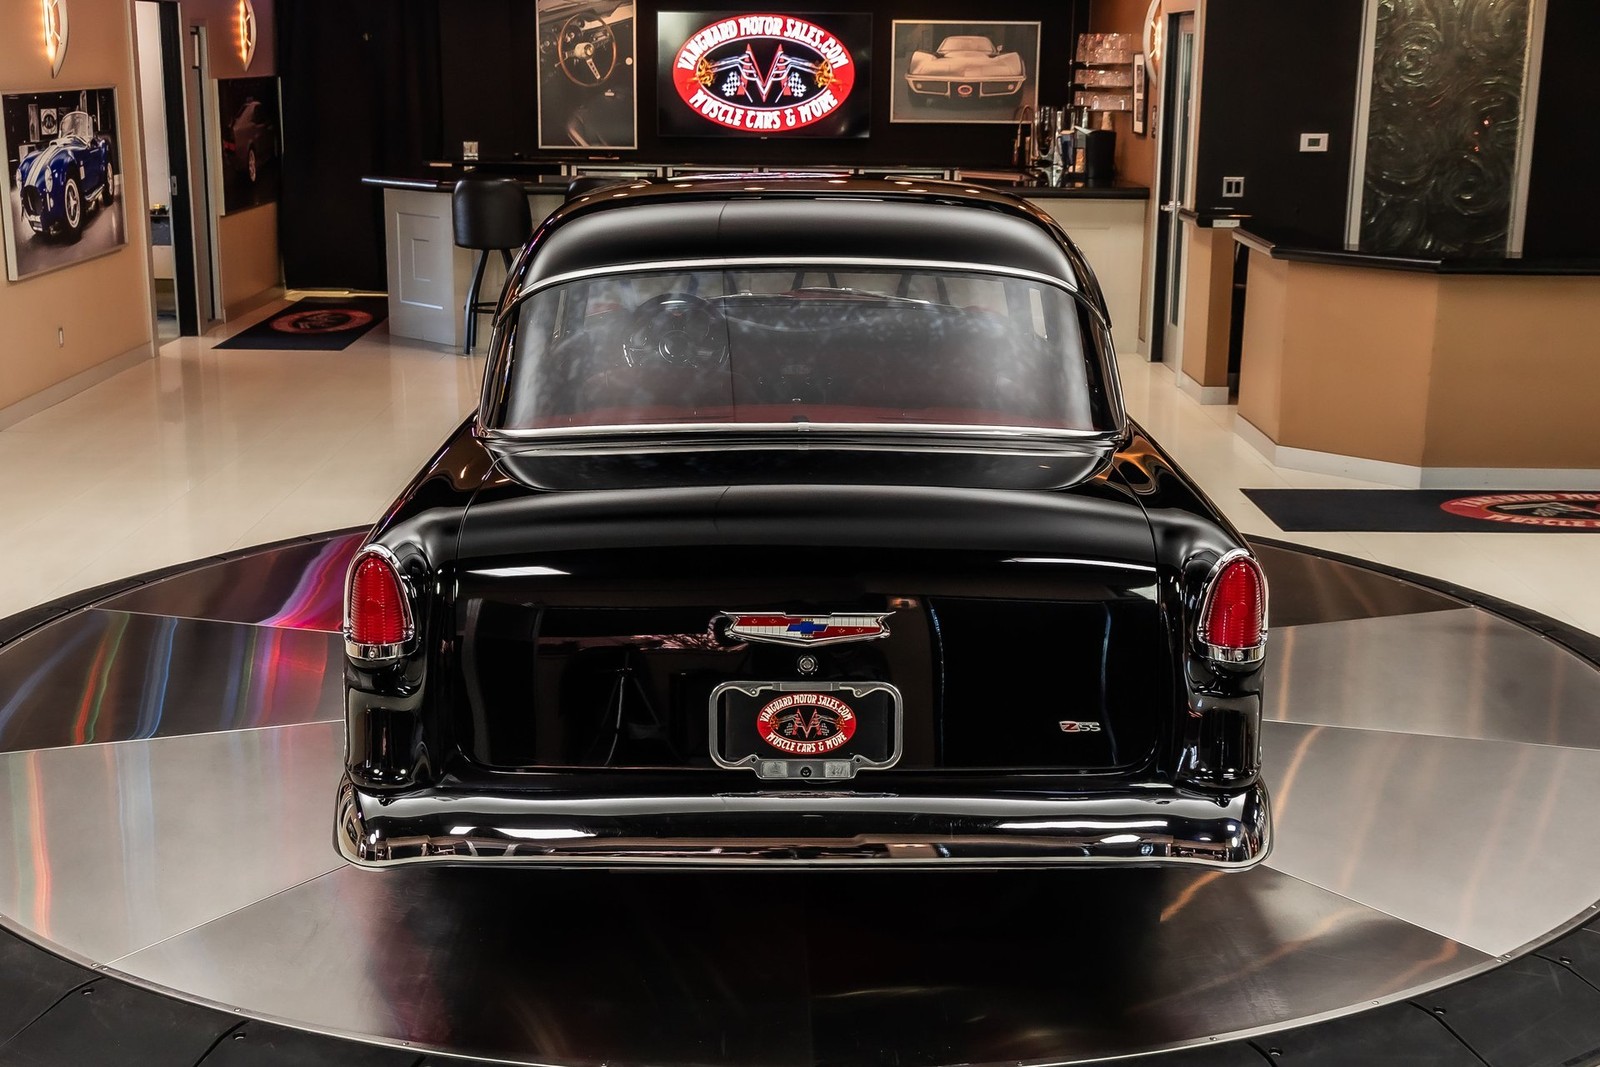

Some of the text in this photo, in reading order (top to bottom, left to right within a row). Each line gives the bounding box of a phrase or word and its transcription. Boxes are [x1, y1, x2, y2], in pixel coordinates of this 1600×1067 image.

[677, 16, 849, 71] VANGUARD MOTOR SALES.COM
[688, 88, 839, 130] MUSCLE CARS & MORE
[759, 694, 853, 723] VANGUARD MOTOR SALES.COM
[765, 732, 847, 753] MUSCLE CARS & MORE
